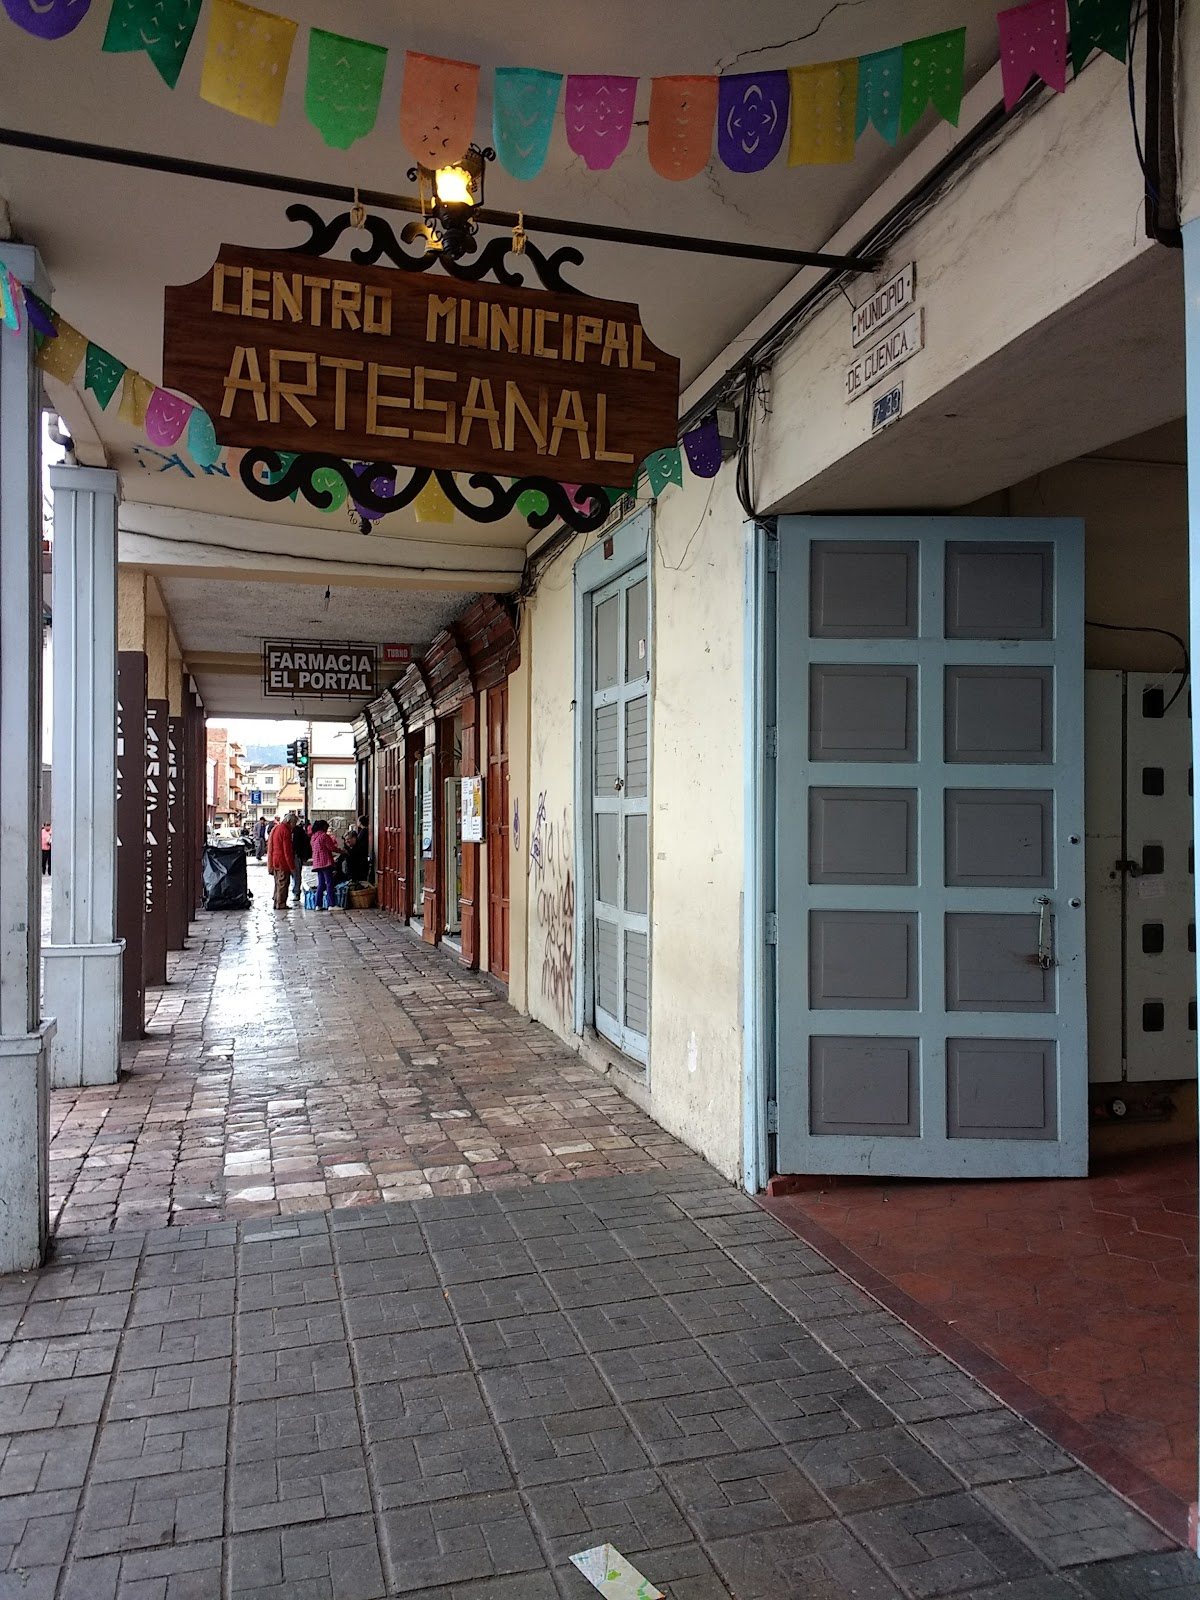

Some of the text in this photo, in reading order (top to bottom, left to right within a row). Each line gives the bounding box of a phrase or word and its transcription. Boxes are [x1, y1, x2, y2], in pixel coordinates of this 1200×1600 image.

[211, 262, 656, 372] CENTRO MUNICIPAL
[857, 277, 904, 337] MUNICIPIO
[848, 330, 909, 394] DE CUENCA
[219, 346, 635, 464] ARTESANAL
[269, 651, 372, 673] FARMACIA
[270, 671, 372, 691] EL PORTAL
